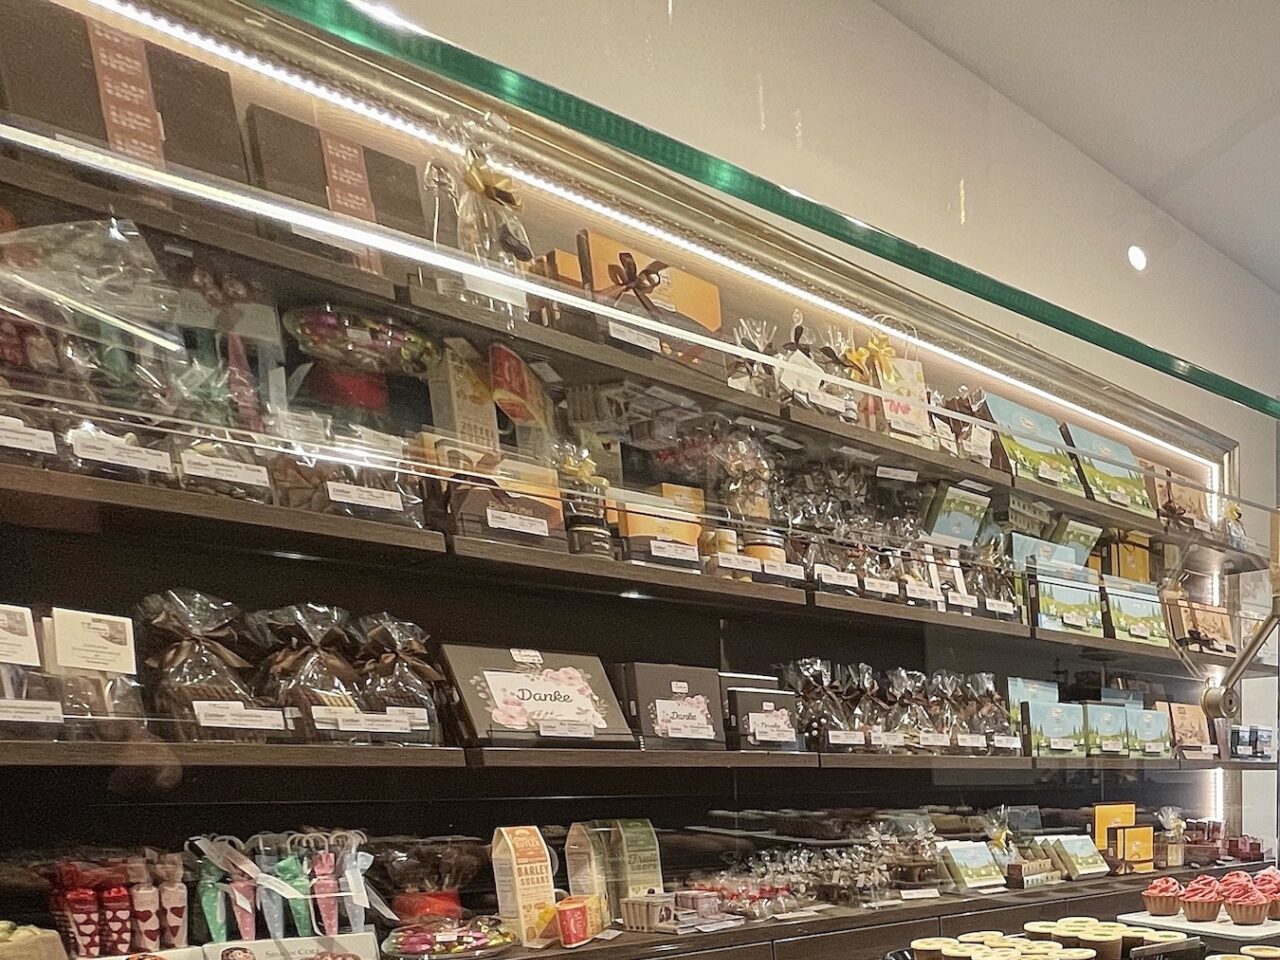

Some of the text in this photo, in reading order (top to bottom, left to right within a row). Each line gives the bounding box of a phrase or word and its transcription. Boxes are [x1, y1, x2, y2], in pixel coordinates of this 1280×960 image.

[516, 687, 573, 703] Danke
[670, 711, 697, 721] Danke
[517, 865, 549, 877] BARLEY
[520, 875, 549, 886] SUGARS
